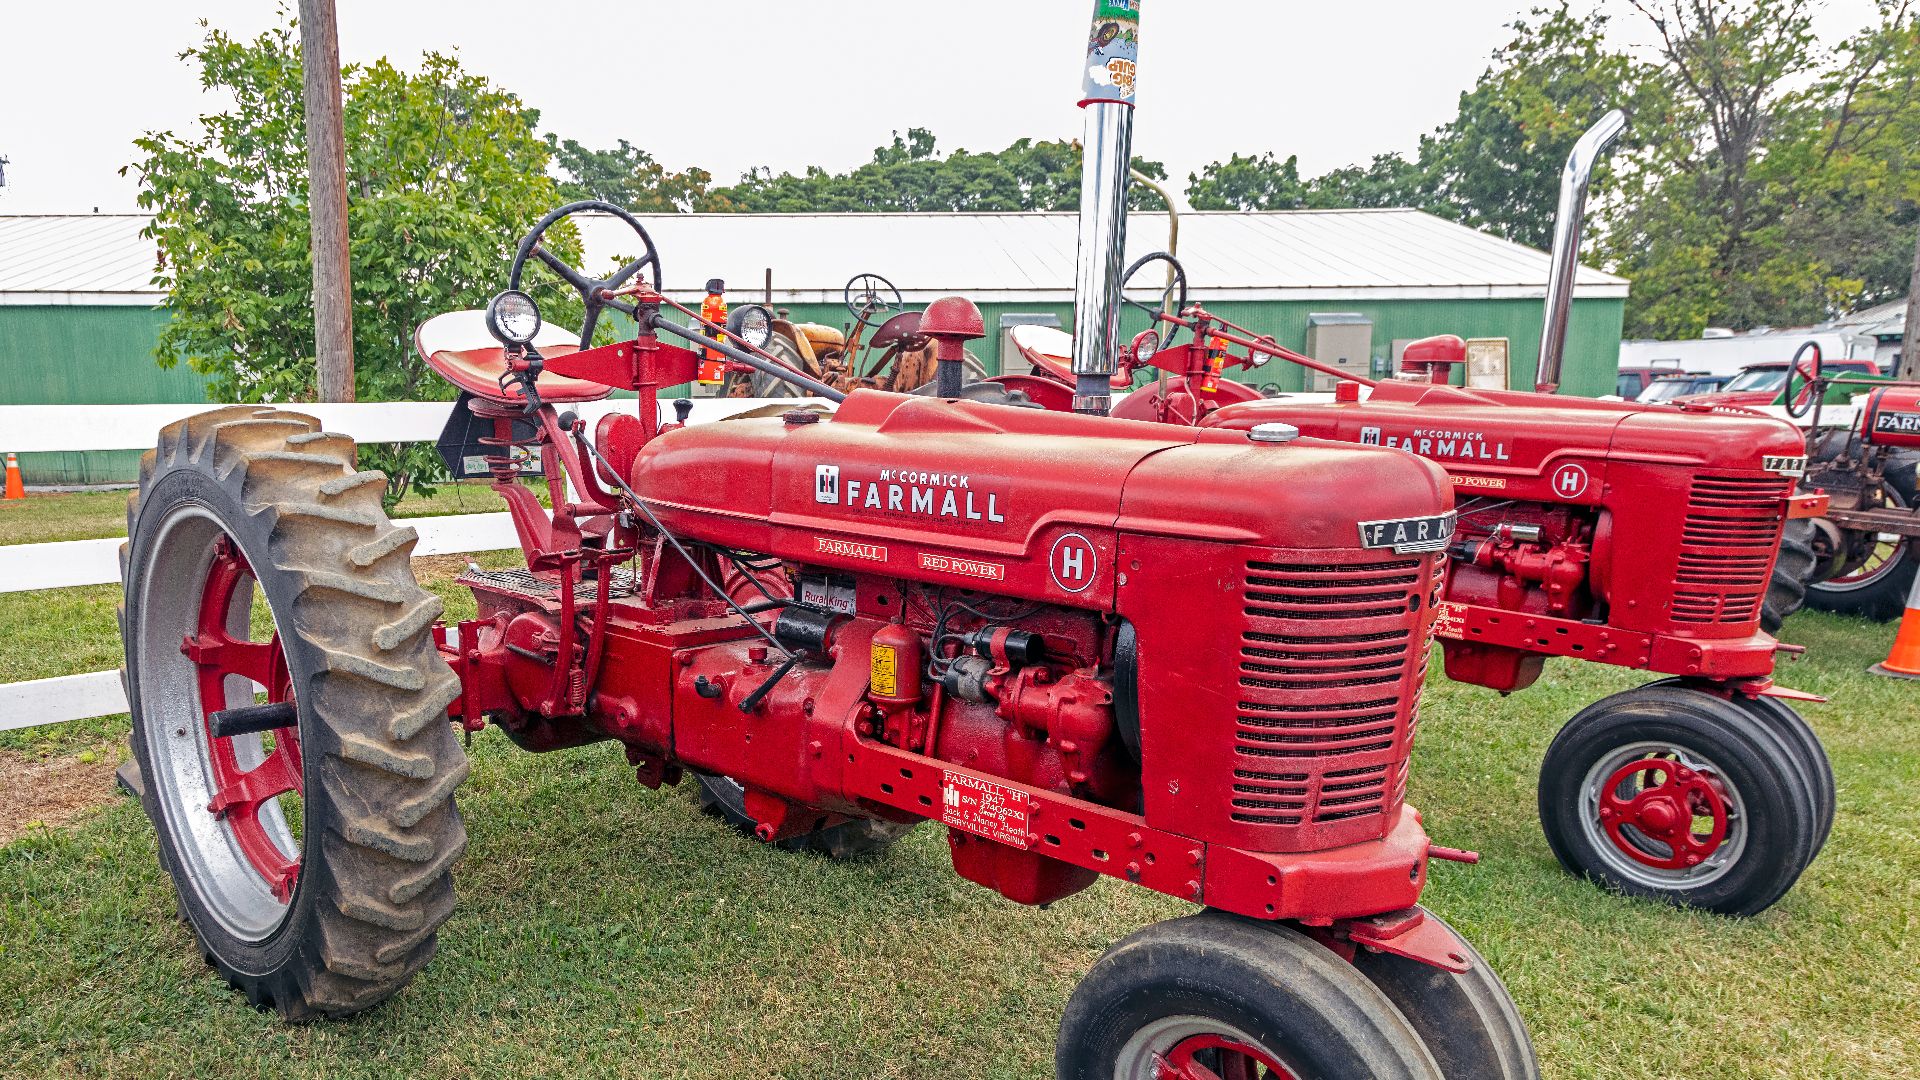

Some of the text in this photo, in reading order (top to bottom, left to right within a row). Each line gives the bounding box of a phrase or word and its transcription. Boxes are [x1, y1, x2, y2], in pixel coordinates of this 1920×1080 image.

[1108, 60, 1136, 76] GULP
[1113, 72, 1133, 86] BIG
[1386, 436, 1509, 460] FARMALL
[880, 469, 970, 489] McCORMICK
[1449, 476, 1503, 488] ED POWER
[1561, 472, 1579, 492] H
[847, 480, 1005, 523] FARMALL
[819, 539, 881, 559] FARMALL
[922, 556, 998, 577] RED POWER
[1062, 546, 1084, 580] H
[805, 591, 827, 605] Rural
[828, 595, 850, 610] King
[944, 772, 1004, 796] FARMALL
[981, 793, 1005, 806] 1947
[943, 805, 1026, 838] Jack & Nancy Heath
[992, 829, 1026, 847] VIRGINIA
